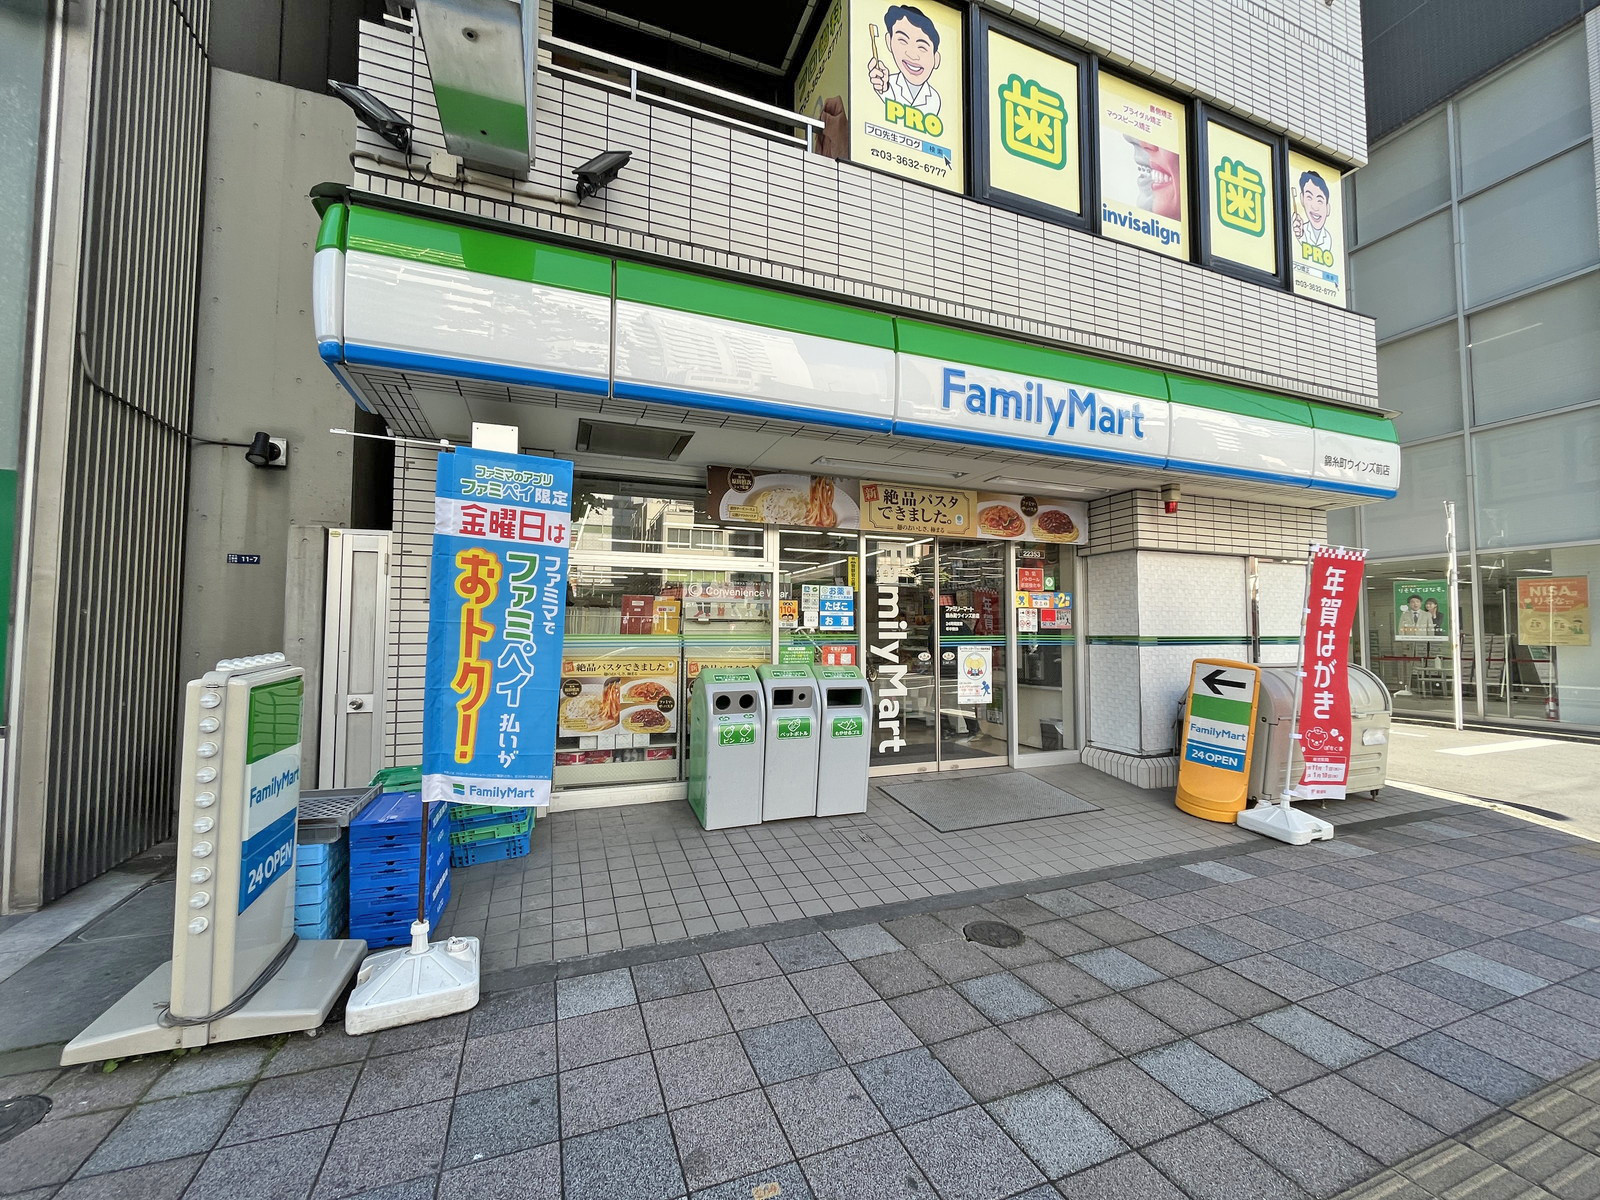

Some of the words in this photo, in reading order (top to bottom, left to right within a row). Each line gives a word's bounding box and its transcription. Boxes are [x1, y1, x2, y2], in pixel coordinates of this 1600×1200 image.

[885, 97, 943, 137] PRO
[998, 74, 1068, 170] 歯
[880, 150, 947, 177] 03-3632-6777
[1215, 156, 1265, 237] 歯
[1103, 203, 1181, 245] invisalign
[1302, 241, 1334, 267] PRO
[942, 367, 1145, 438] FamilyMart
[475, 465, 553, 486] ファミマのアプリ
[1324, 455, 1390, 476] 錦糸町ウインズ前店
[865, 487, 876, 499] 新
[883, 489, 959, 509] 絶品パスタ
[459, 503, 565, 544] 金曜日は
[878, 505, 952, 525] できました。
[542, 556, 561, 635] ファミマで
[706, 585, 764, 597] Convenience
[825, 601, 849, 611] たばこ
[870, 541, 908, 754] milyMart
[1313, 566, 1347, 720] 年賀はがき
[1190, 723, 1246, 742] FamilyMart
[249, 767, 300, 808] FamilyMart
[469, 785, 535, 799] FamilyMart
